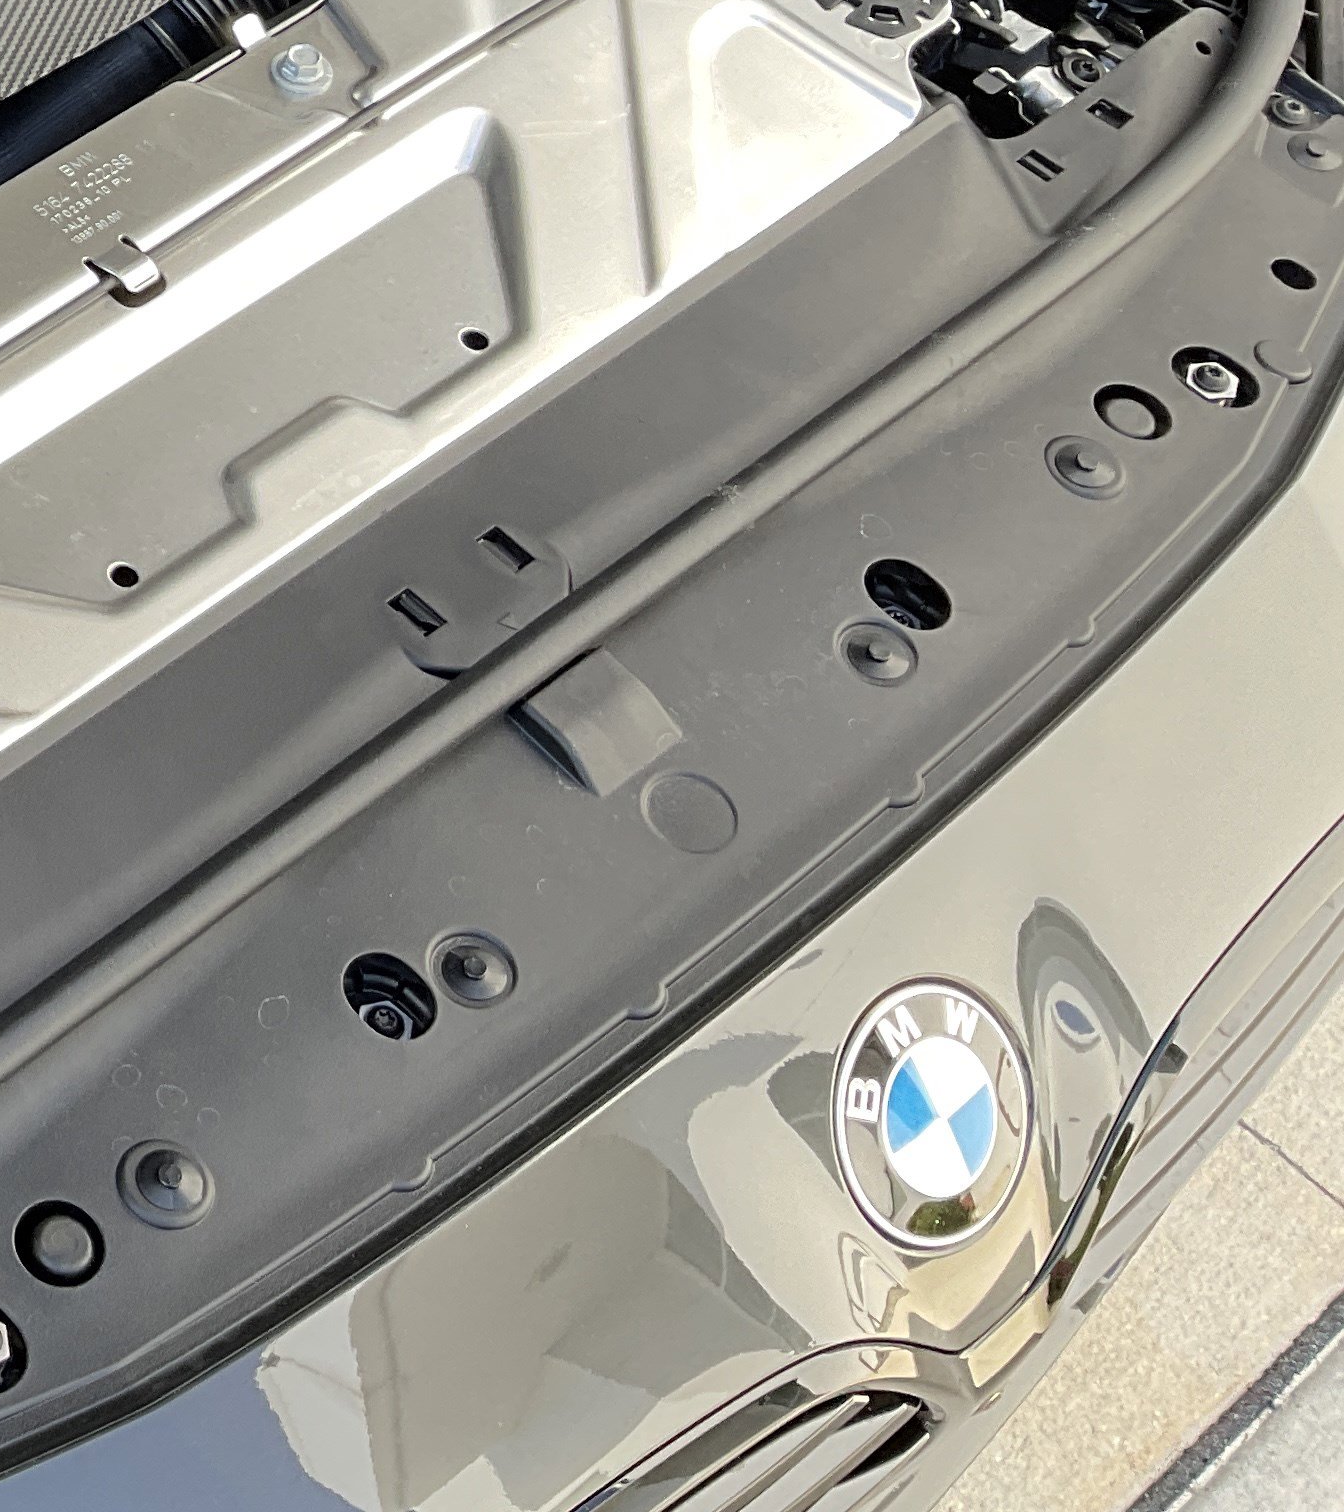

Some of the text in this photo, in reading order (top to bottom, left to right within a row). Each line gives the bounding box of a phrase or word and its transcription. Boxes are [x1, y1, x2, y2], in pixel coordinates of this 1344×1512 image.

[58, 151, 97, 178] BMW
[32, 194, 71, 219] 5164
[846, 998, 980, 1123] BMW
